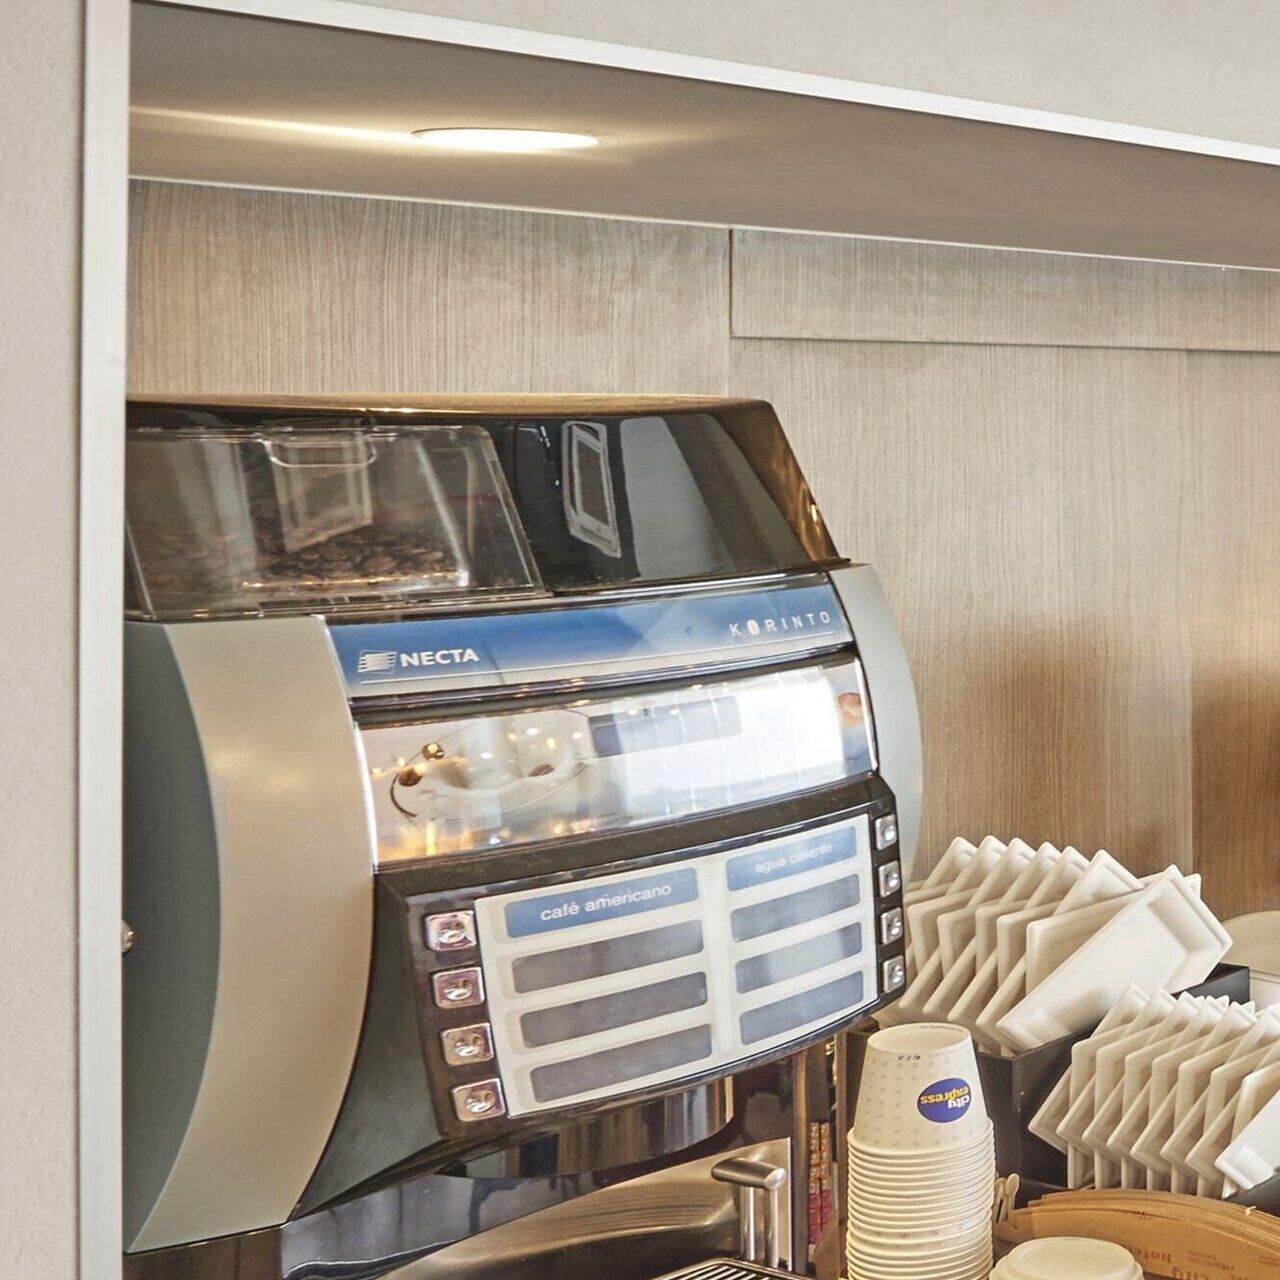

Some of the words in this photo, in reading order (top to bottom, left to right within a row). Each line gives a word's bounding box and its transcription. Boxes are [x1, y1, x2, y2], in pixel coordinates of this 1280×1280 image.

[729, 611, 829, 636] KORINTO
[400, 648, 479, 667] NECTA
[755, 856, 786, 874] agua
[540, 902, 579, 921] café
[585, 883, 672, 912] americano
[920, 1086, 969, 1104] express
